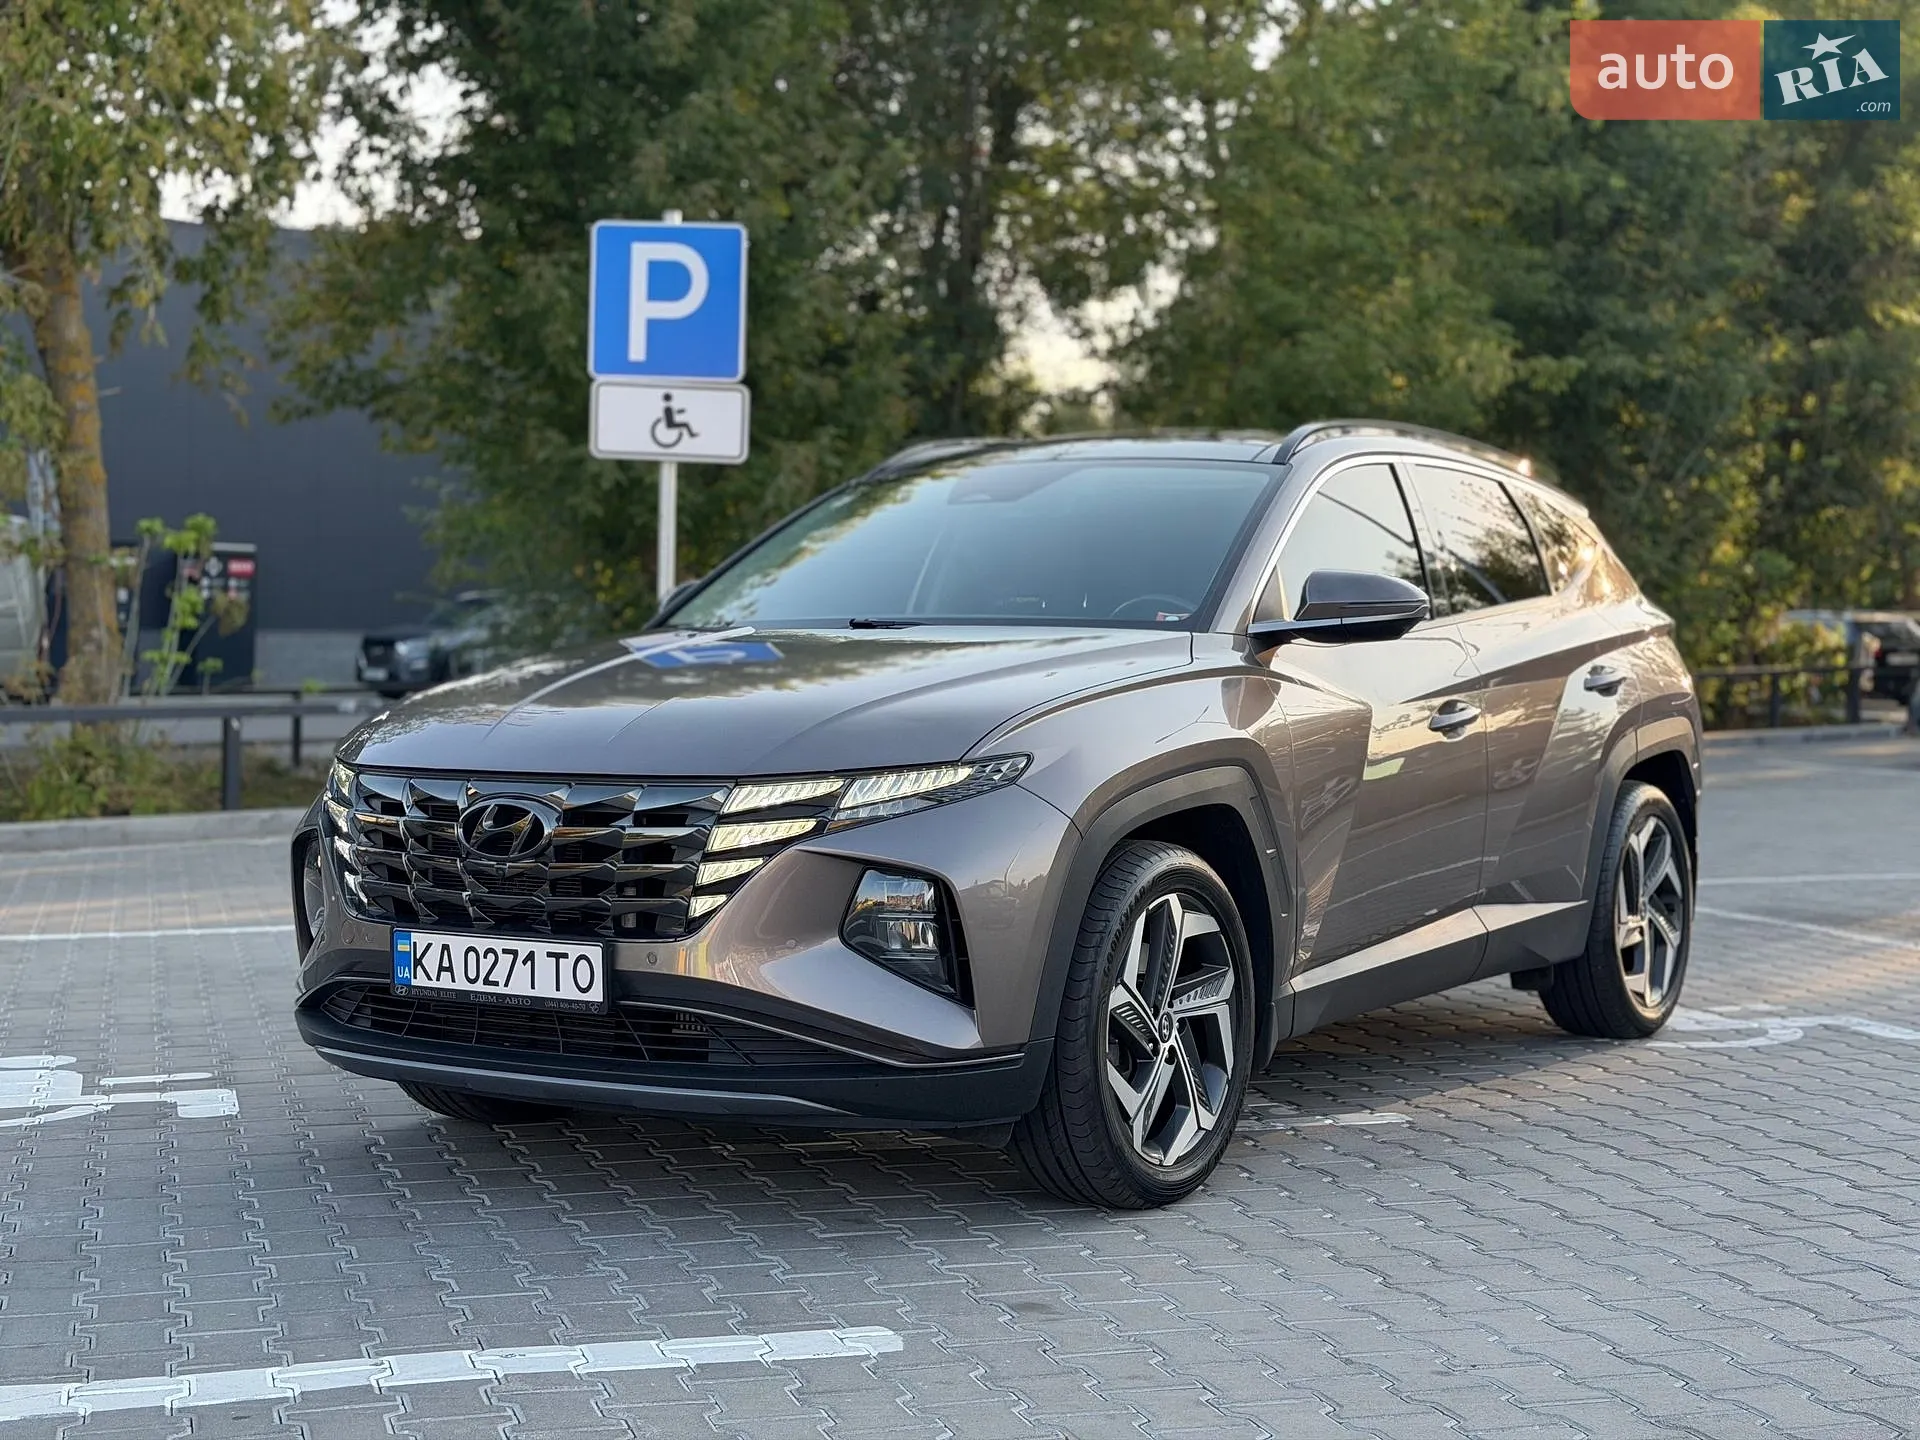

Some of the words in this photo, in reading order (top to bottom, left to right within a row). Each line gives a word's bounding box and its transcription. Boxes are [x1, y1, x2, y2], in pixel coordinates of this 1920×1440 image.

[627, 241, 710, 363] P
[397, 965, 411, 979] UA
[412, 941, 457, 984] KA
[463, 945, 537, 991] 0271
[546, 950, 596, 995] TO
[504, 996, 531, 1006] АВТО
